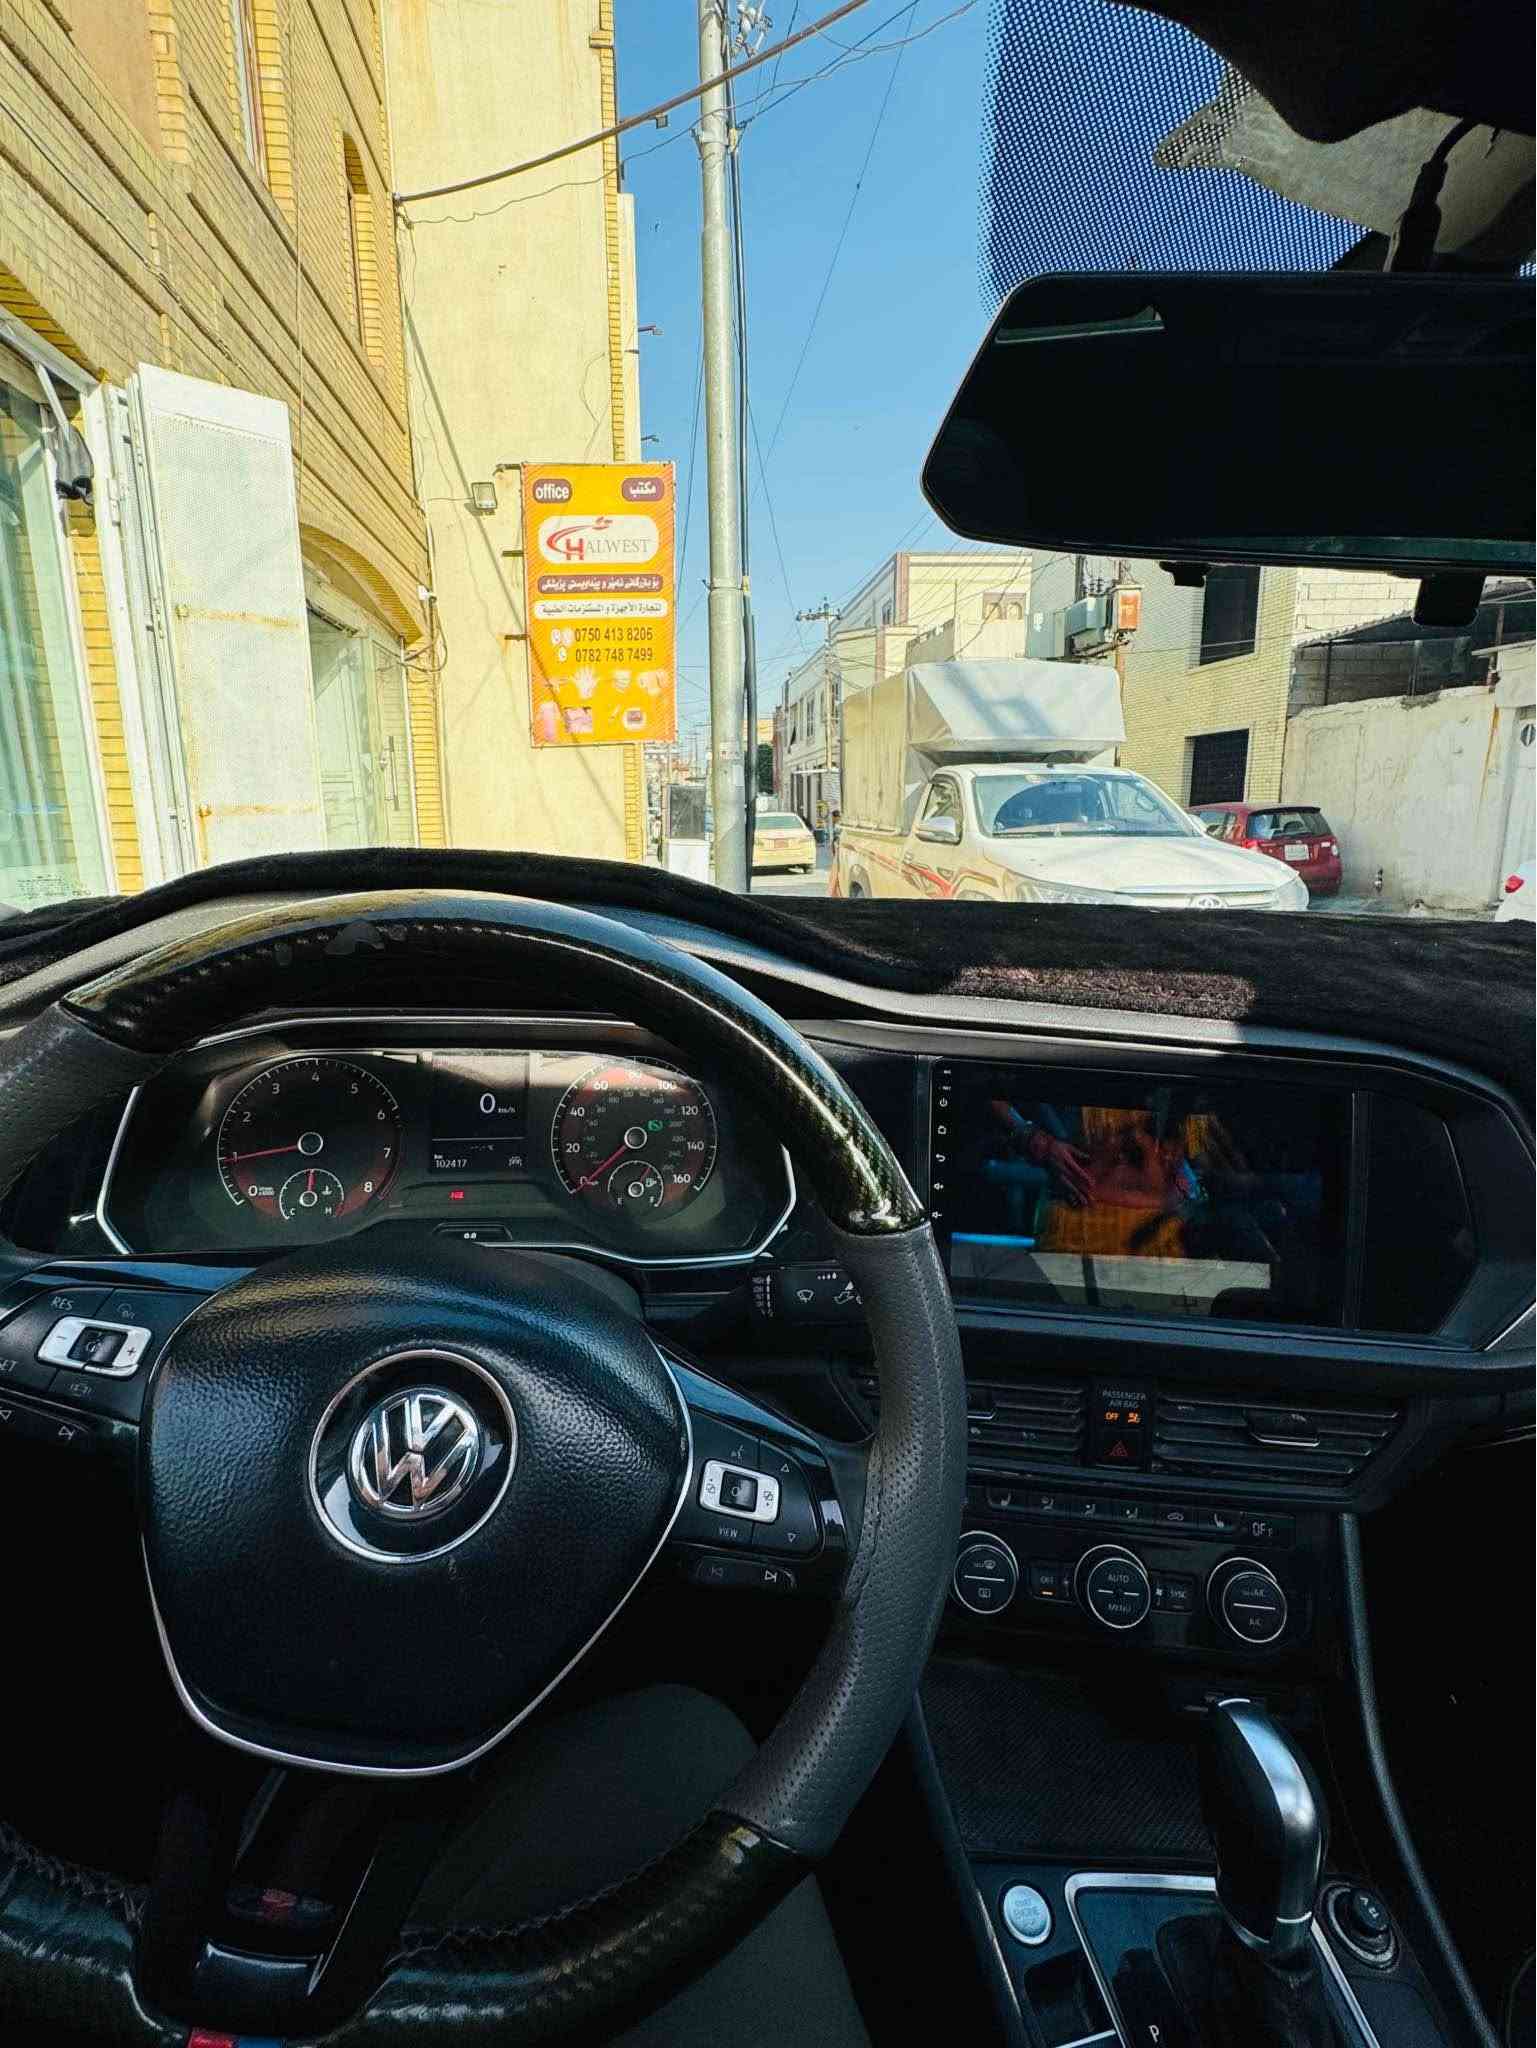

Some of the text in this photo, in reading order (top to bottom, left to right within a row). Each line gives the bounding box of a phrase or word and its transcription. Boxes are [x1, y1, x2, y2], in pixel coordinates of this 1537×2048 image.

[535, 483, 570, 500] office
[629, 481, 656, 498] مكتب
[575, 627, 600, 641] 0750
[604, 627, 624, 641] 413
[576, 647, 653, 662] 0782 748 7499
[312, 1073, 320, 1082] 4
[272, 1083, 280, 1094] 3
[351, 1083, 359, 1094] 5
[593, 1081, 608, 1090] 60
[657, 1080, 677, 1090] 100
[480, 1093, 496, 1114] 0
[377, 1111, 385, 1120] 6
[570, 1107, 585, 1117] 40
[681, 1106, 698, 1116] 120
[243, 1112, 251, 1122] 2
[566, 1143, 580, 1153] 20
[687, 1141, 705, 1151] 140
[233, 1152, 238, 1162] 1
[384, 1148, 392, 1158] 7
[435, 1159, 468, 1168] 102417
[672, 1174, 691, 1184] 160
[248, 1186, 258, 1197] 0
[364, 1182, 373, 1192] 8
[290, 1208, 296, 1216] C
[325, 1207, 332, 1215] H
[50, 1296, 74, 1311] RES
[1105, 1412, 1119, 1421] OFF
[1107, 1574, 1130, 1584] AUTO
[1148, 2024, 1160, 2043] P
